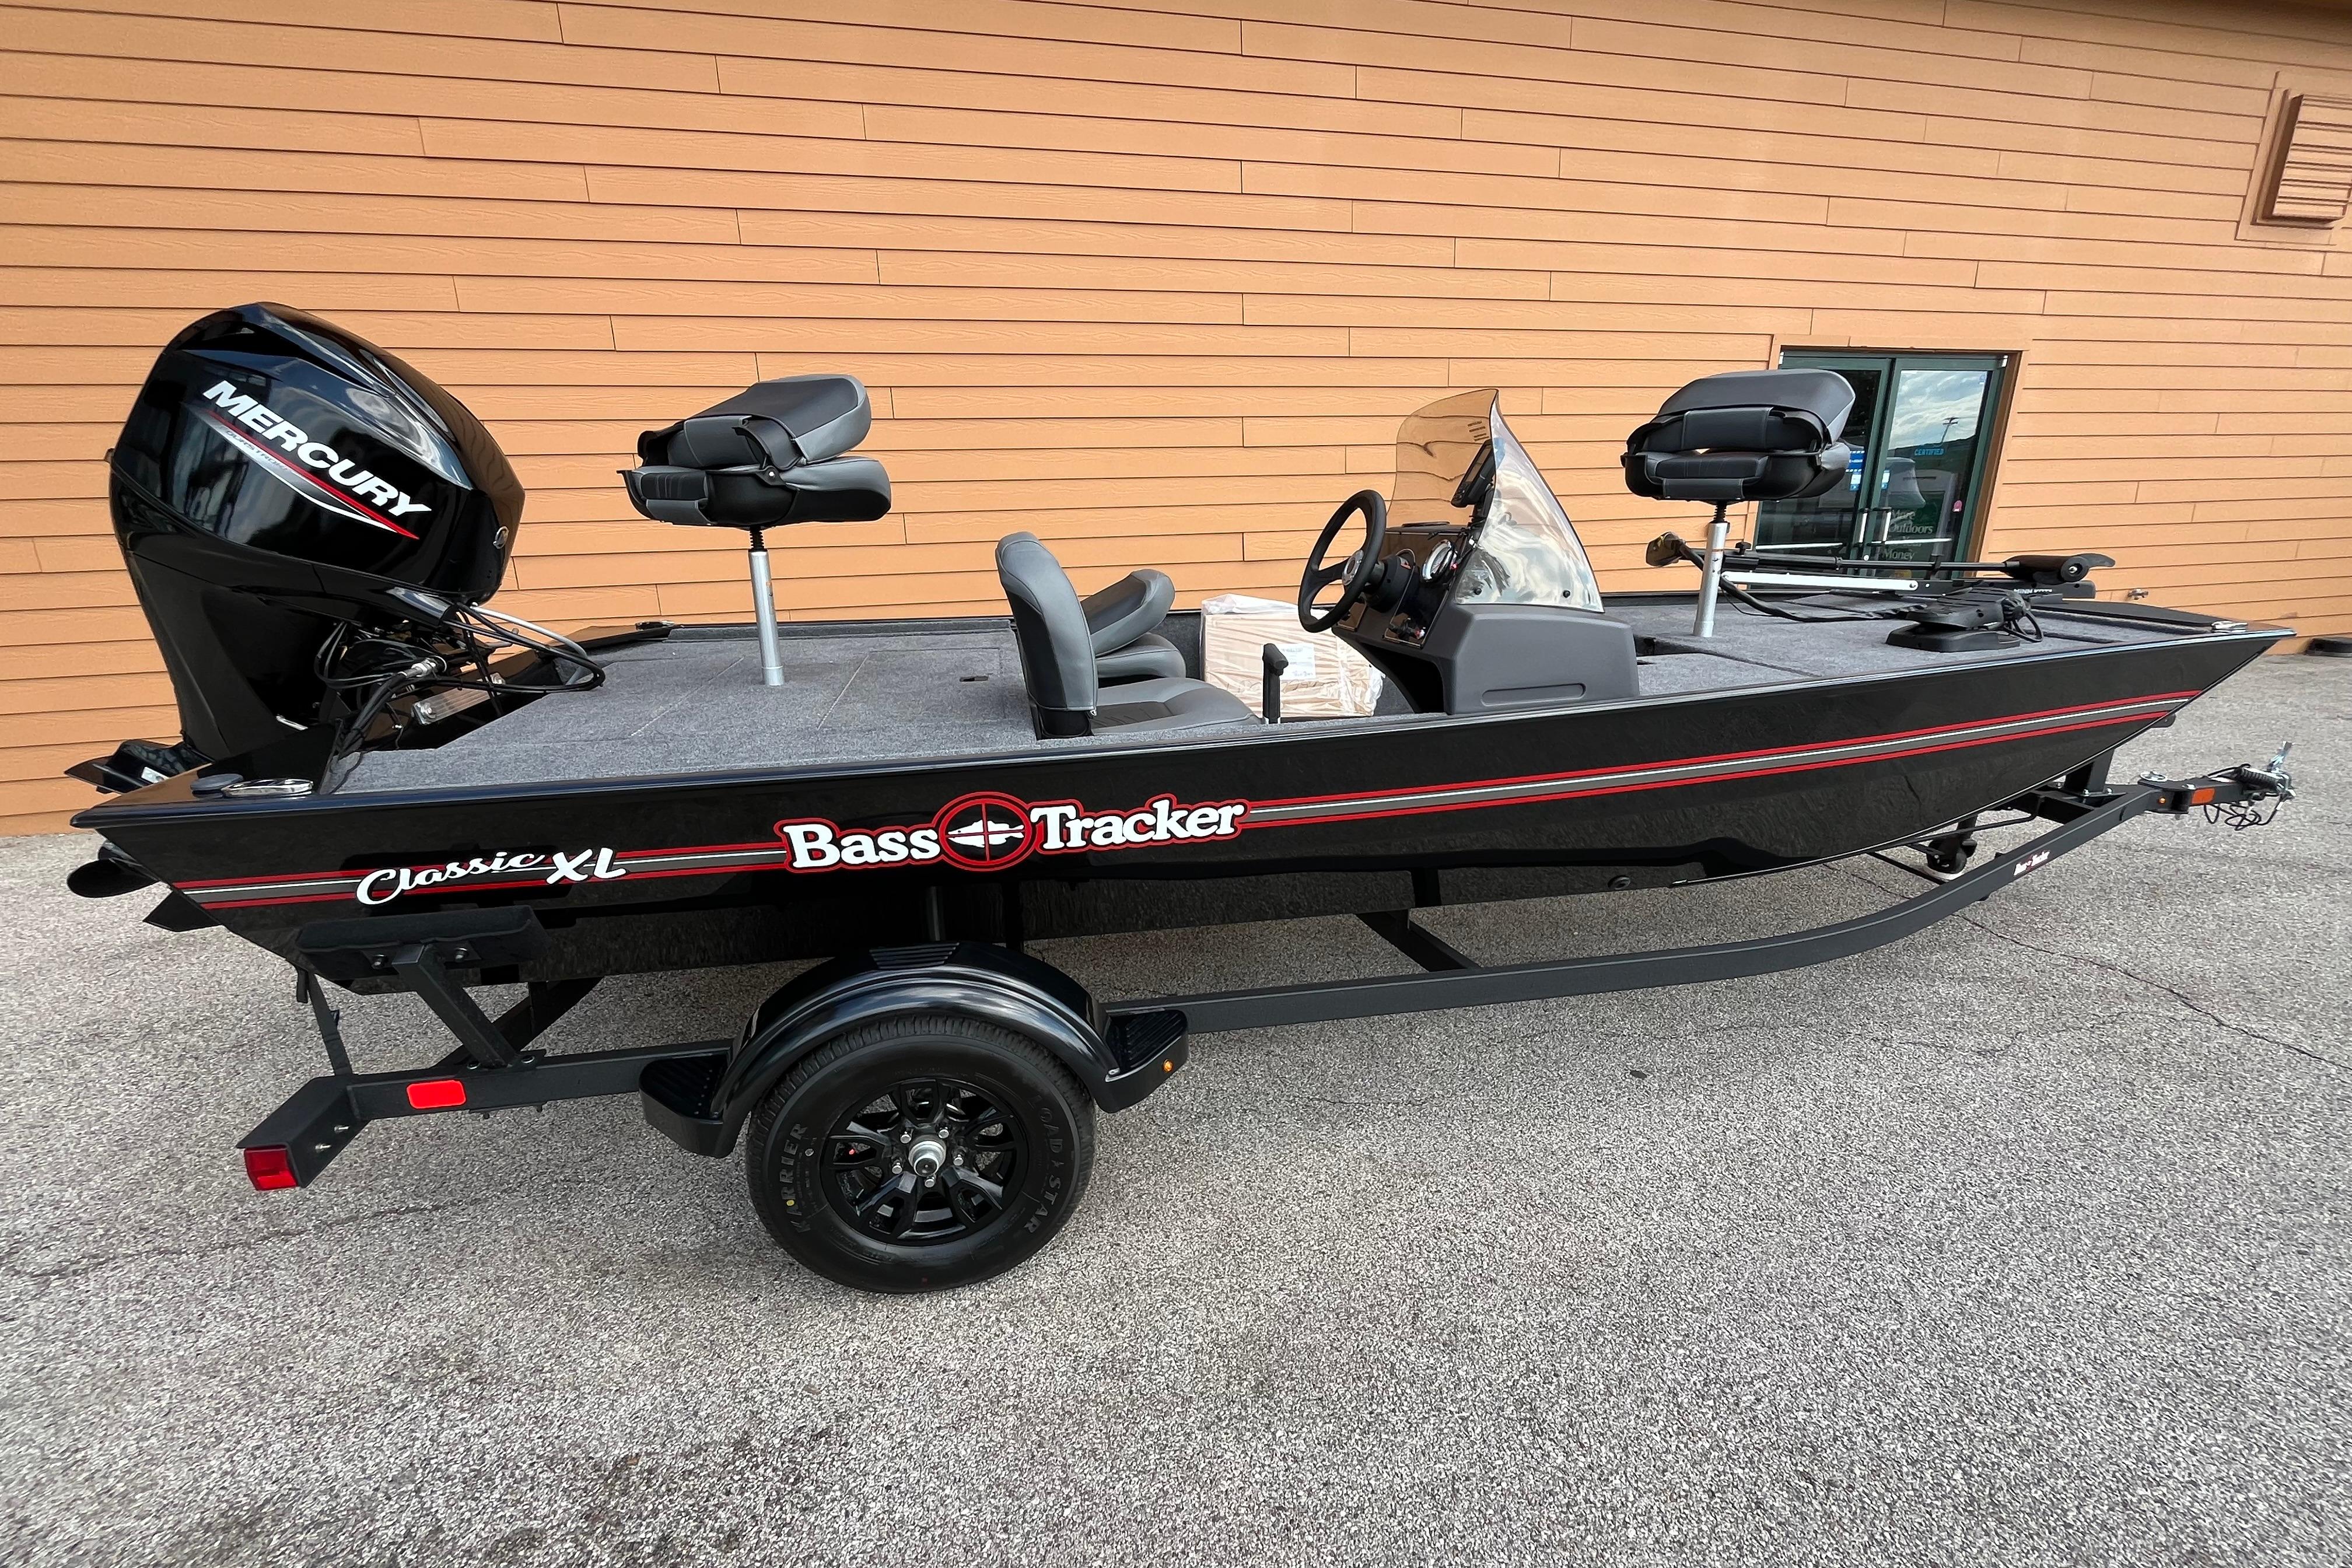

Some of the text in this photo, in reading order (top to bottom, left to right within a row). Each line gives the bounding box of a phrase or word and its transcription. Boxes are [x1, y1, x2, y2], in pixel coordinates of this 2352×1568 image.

[202, 380, 432, 516] MERCURY
[1914, 448, 1944, 456] CERTIFIED
[1884, 547, 1916, 562] Money
[1889, 522, 1933, 534] Outdoors
[783, 799, 1244, 869] Bass Tracker
[356, 847, 626, 905] Classic XL
[779, 1124, 811, 1233] KARRIER
[1024, 1094, 1063, 1233] LOAD STAR
